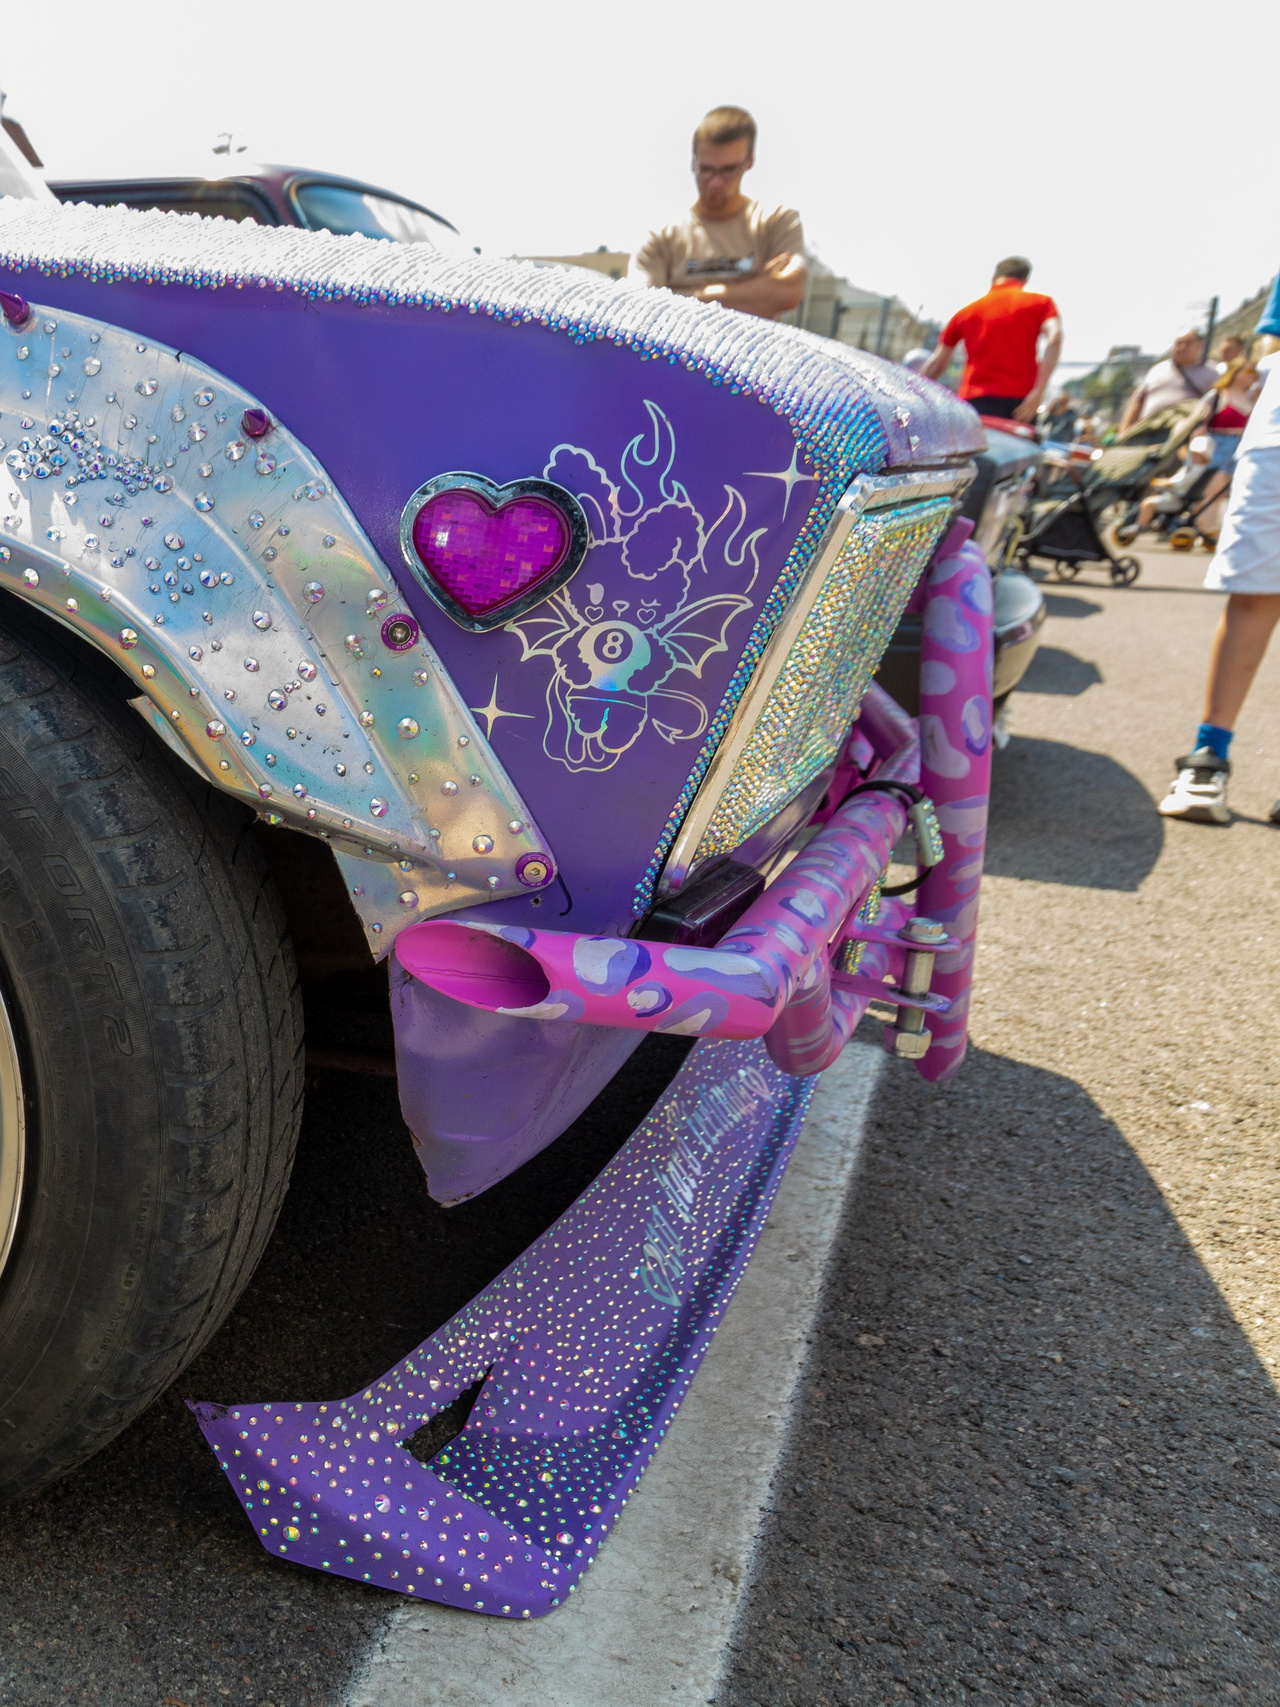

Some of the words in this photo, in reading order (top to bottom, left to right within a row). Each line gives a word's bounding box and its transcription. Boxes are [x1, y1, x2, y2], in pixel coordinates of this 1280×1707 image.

[602, 631, 624, 659] 8
[102, 1014, 135, 1057] 2
[99, 1300, 125, 1351] TRACTION
